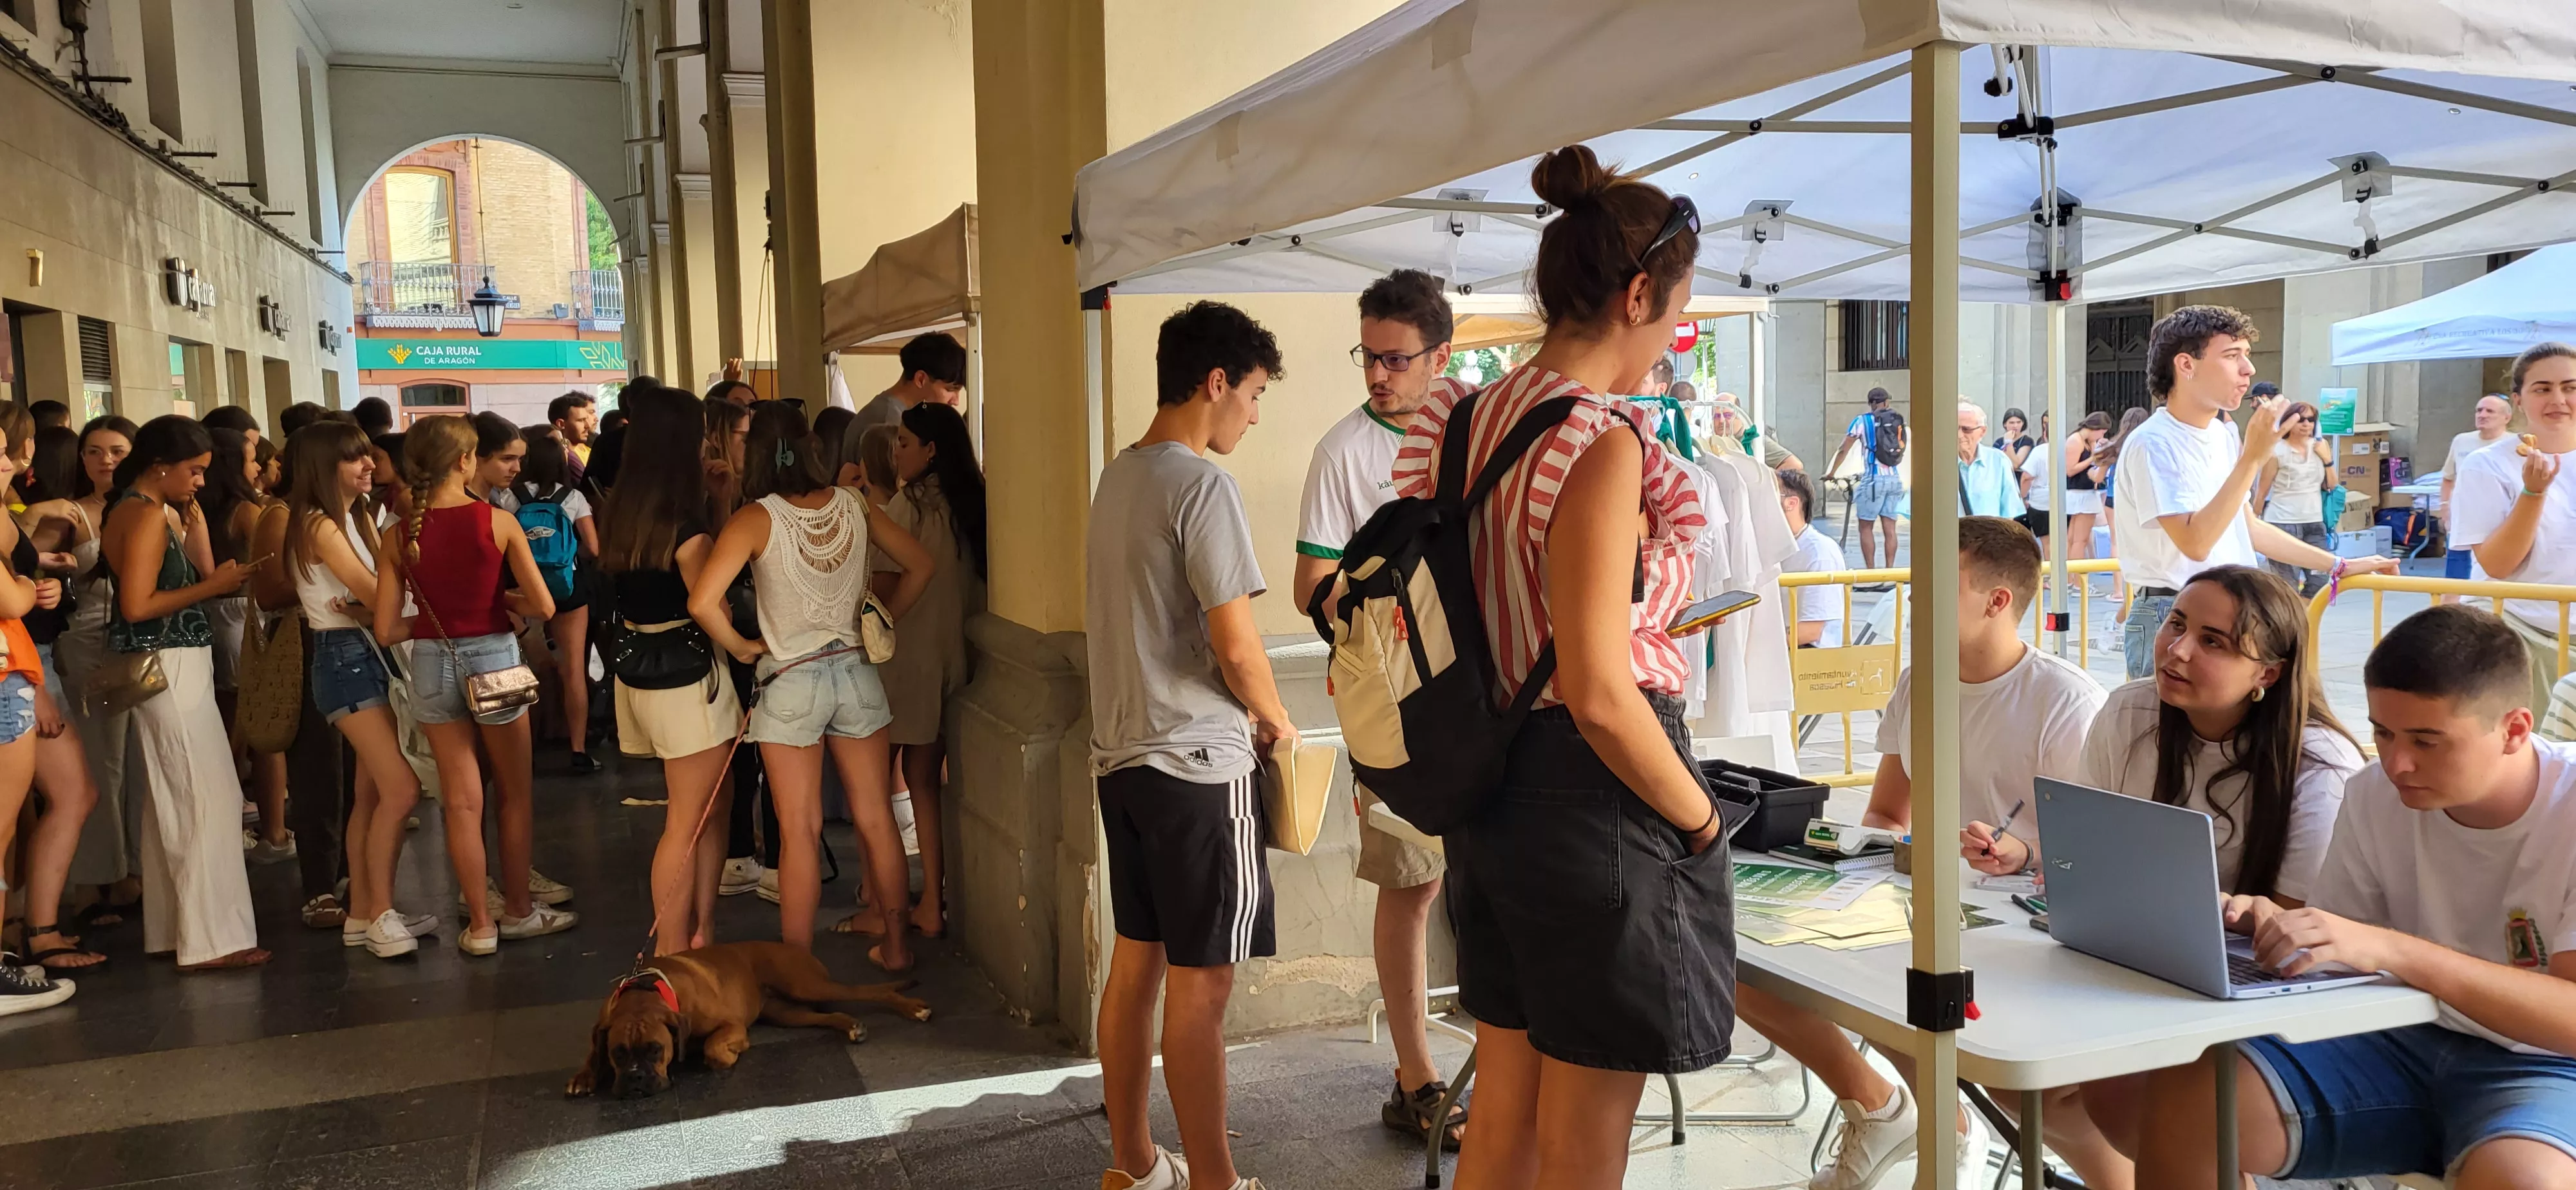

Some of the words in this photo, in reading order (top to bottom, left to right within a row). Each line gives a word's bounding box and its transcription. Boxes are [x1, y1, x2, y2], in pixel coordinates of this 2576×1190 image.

[416, 346, 444, 355] CAJA
[446, 346, 482, 355] RURAL
[438, 356, 475, 364] ARAGÓN
[1184, 755, 1213, 768] adidas
